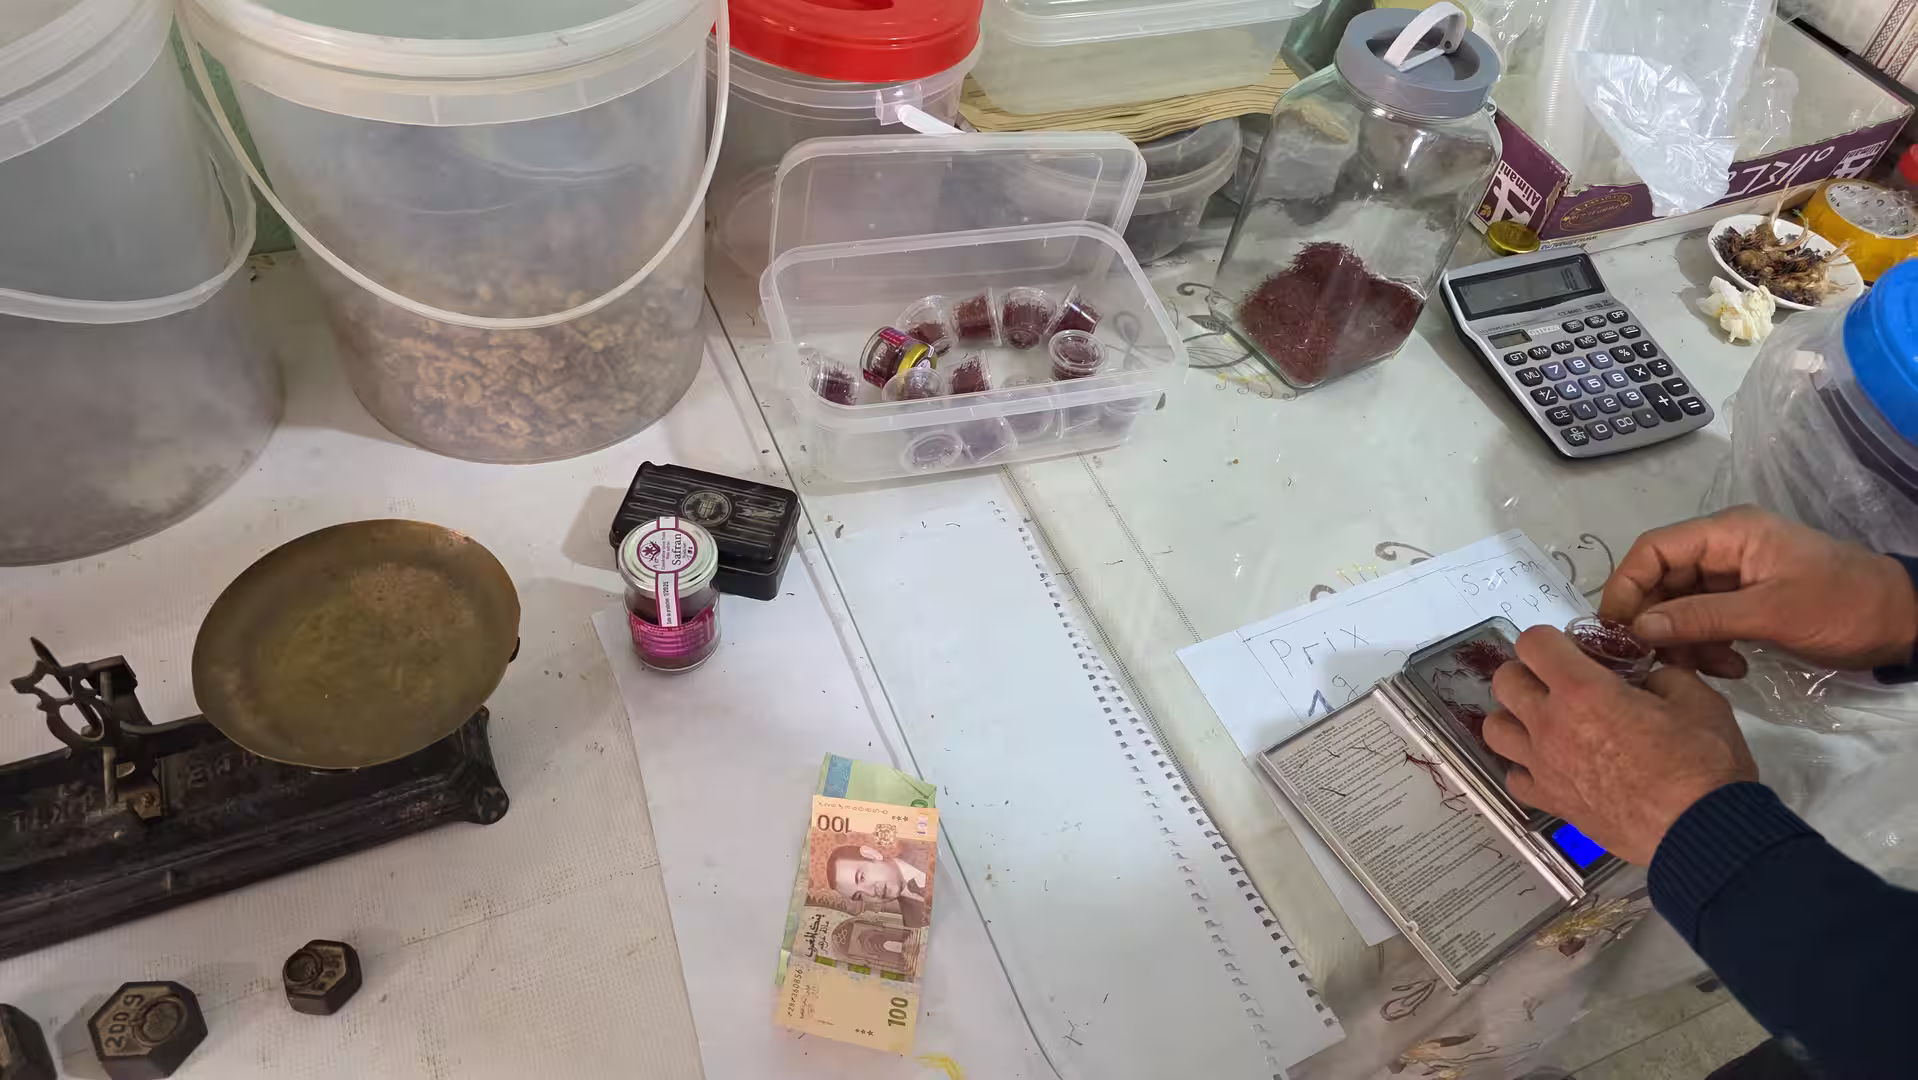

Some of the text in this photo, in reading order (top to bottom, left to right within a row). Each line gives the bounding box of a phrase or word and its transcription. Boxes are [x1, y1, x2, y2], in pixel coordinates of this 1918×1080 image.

[1498, 163, 1540, 206] Alimani
[1612, 311, 1626, 319] OFF
[1527, 324, 1560, 336] CITIZEN
[1510, 353, 1524, 361] GT
[1533, 347, 1548, 356] M+
[1556, 342, 1571, 351] M-
[1524, 371, 1539, 380] MU
[1548, 365, 1559, 375] 7
[1573, 359, 1585, 369] 8
[1596, 354, 1609, 363] 9
[1618, 348, 1631, 357] %
[1566, 383, 1577, 393] 4
[1588, 378, 1601, 388] 5
[1612, 373, 1624, 382] 6
[1555, 409, 1570, 420] CE
[1582, 404, 1591, 413] 1
[1603, 398, 1616, 408] 2
[1625, 391, 1639, 401] 3
[1595, 424, 1608, 433] 0
[1616, 417, 1634, 427] 00
[671, 533, 682, 566] Safran
[817, 814, 852, 833] 100
[887, 996, 909, 1028] 100
